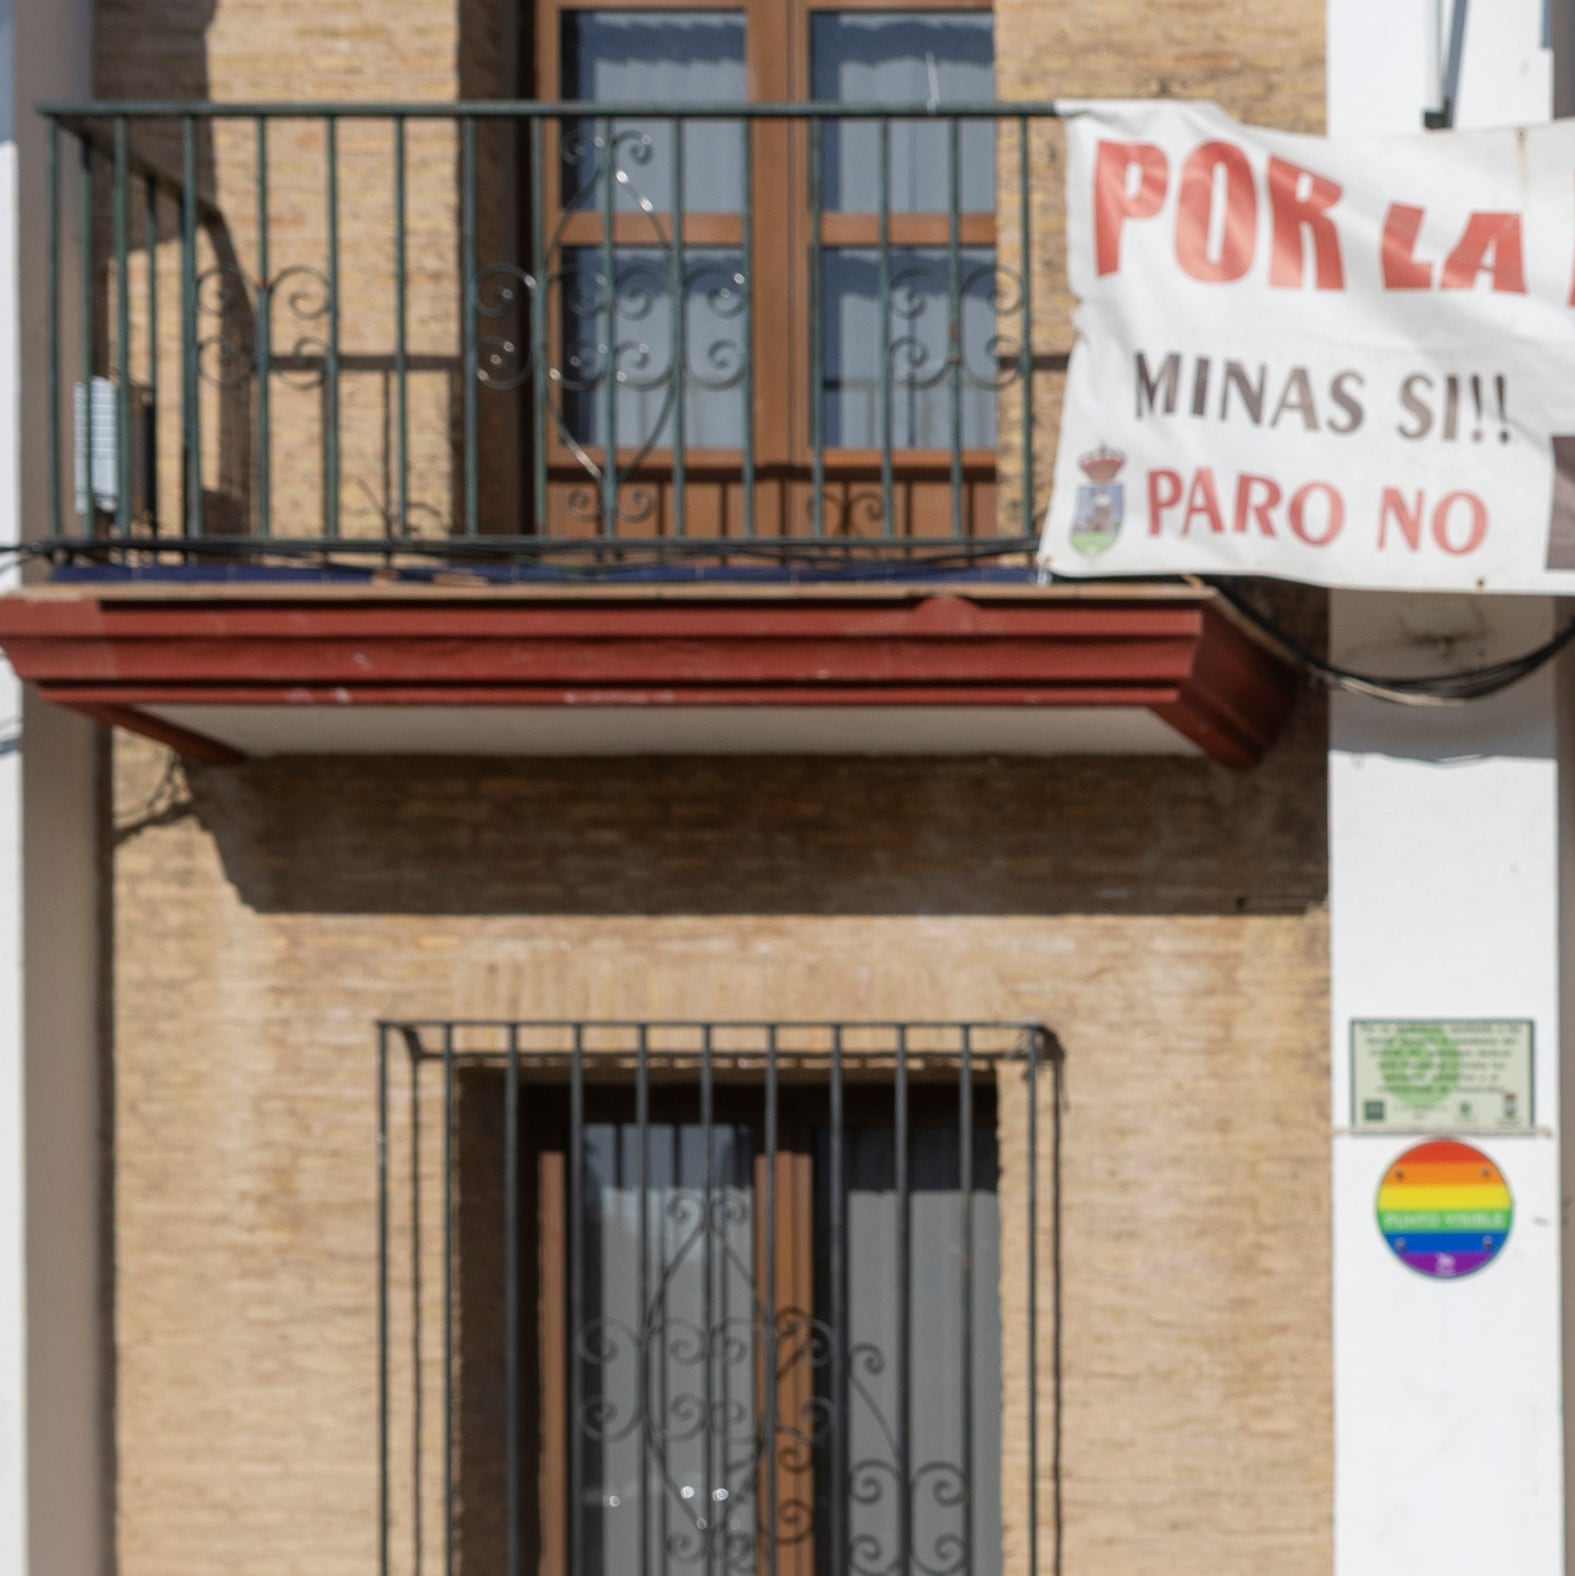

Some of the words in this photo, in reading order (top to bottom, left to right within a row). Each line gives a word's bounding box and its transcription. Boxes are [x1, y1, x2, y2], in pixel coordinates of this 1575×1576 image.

[1092, 138, 1346, 292] POR
[1379, 202, 1527, 295] LA
[1133, 350, 1364, 434] MINAS
[1398, 371, 1510, 443] SI!!
[1146, 464, 1345, 547] PARO
[1377, 487, 1489, 556] NO
